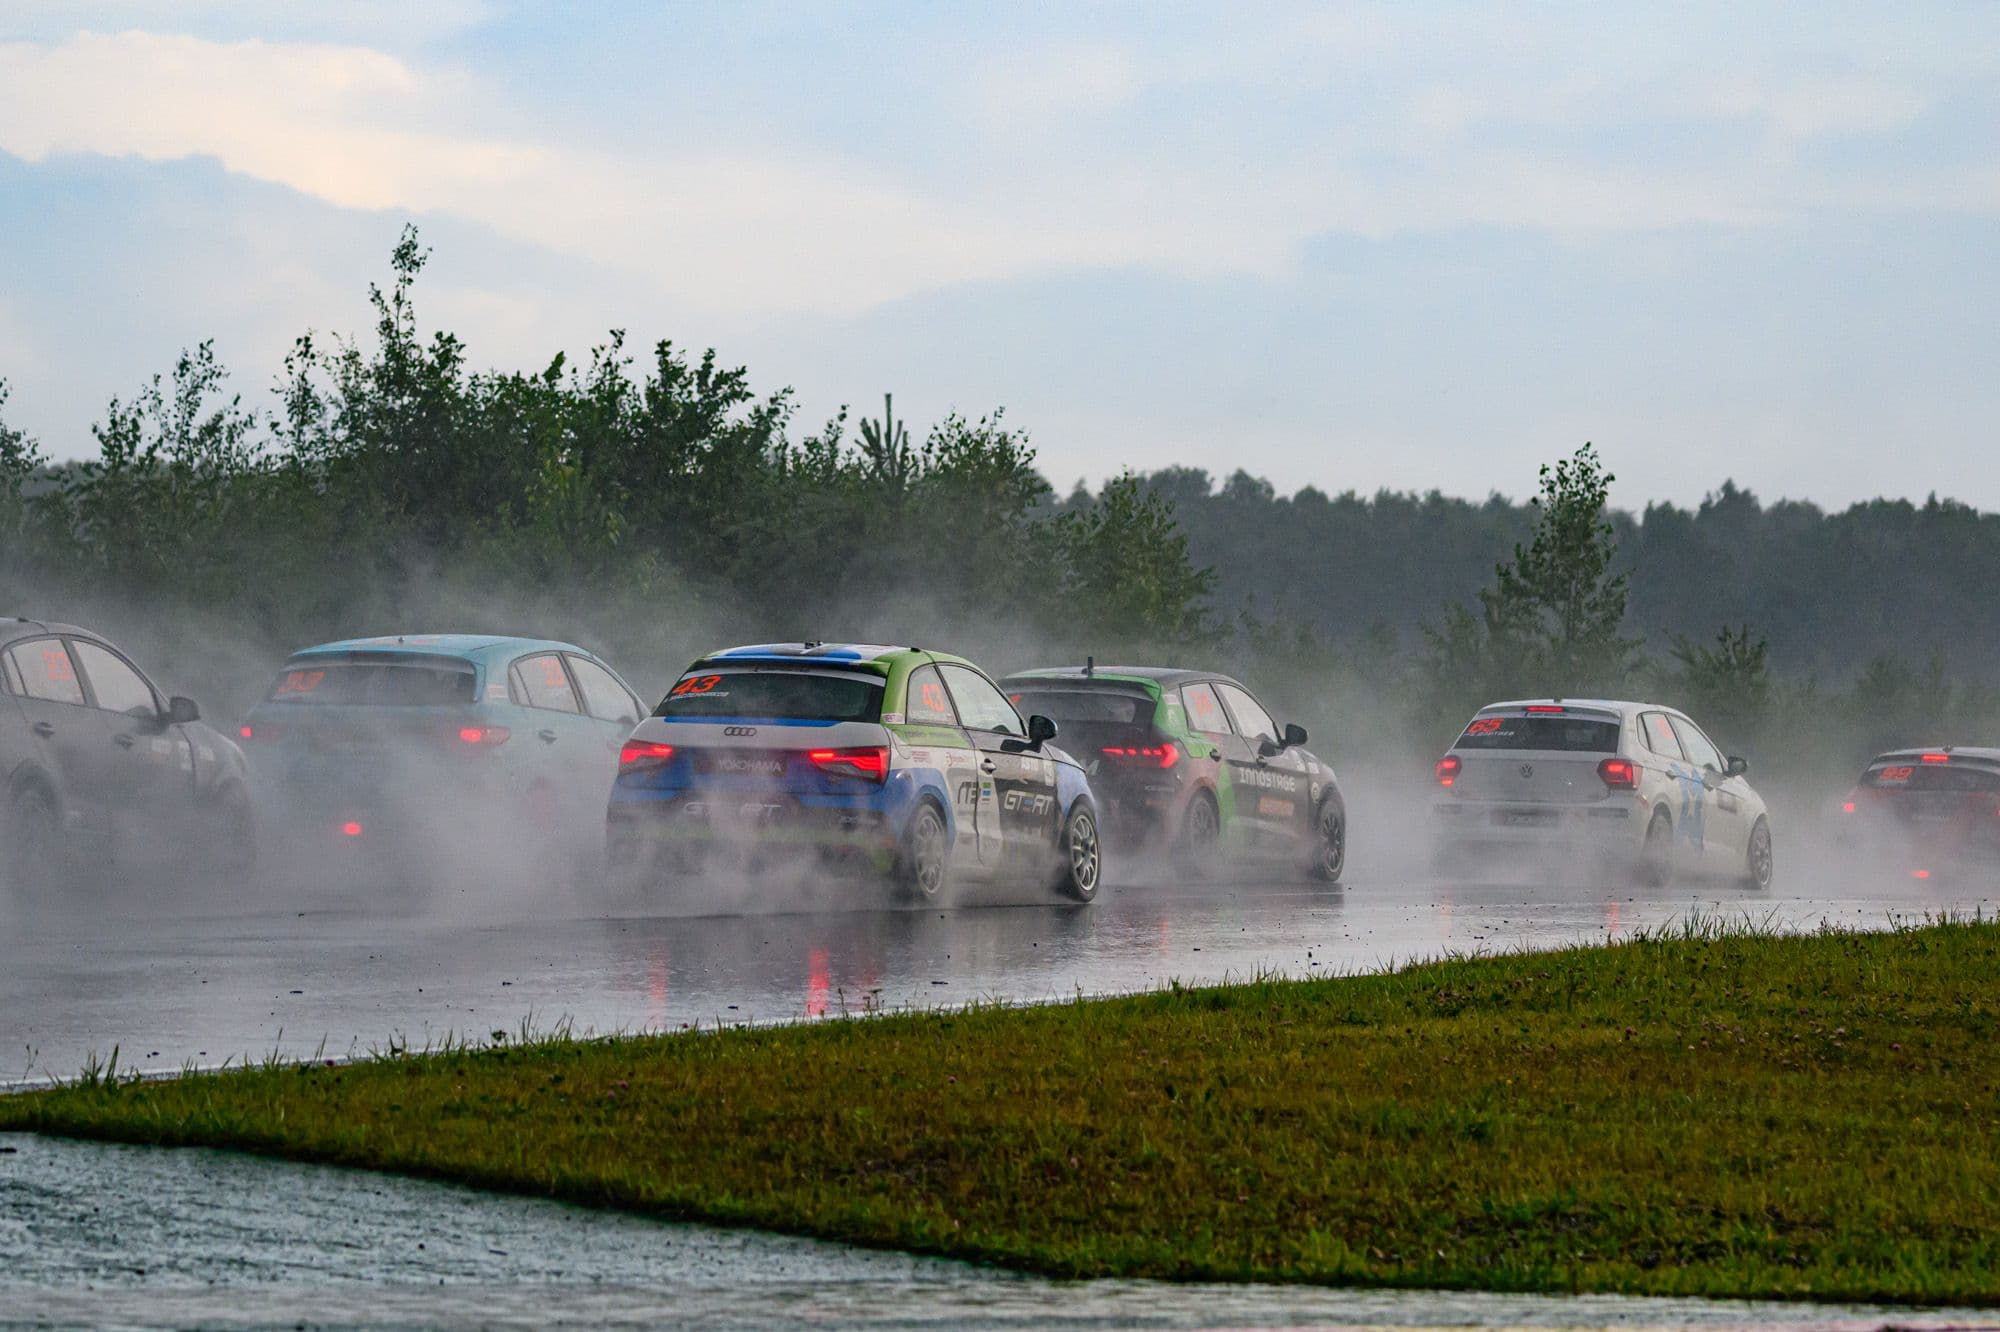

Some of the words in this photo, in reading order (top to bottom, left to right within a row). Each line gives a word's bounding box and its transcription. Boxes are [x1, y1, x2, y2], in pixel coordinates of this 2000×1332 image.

[672, 675, 721, 694] 43
[922, 683, 945, 713] 43
[1467, 717, 1505, 735] 65
[719, 759, 782, 772] YOKOHAMA
